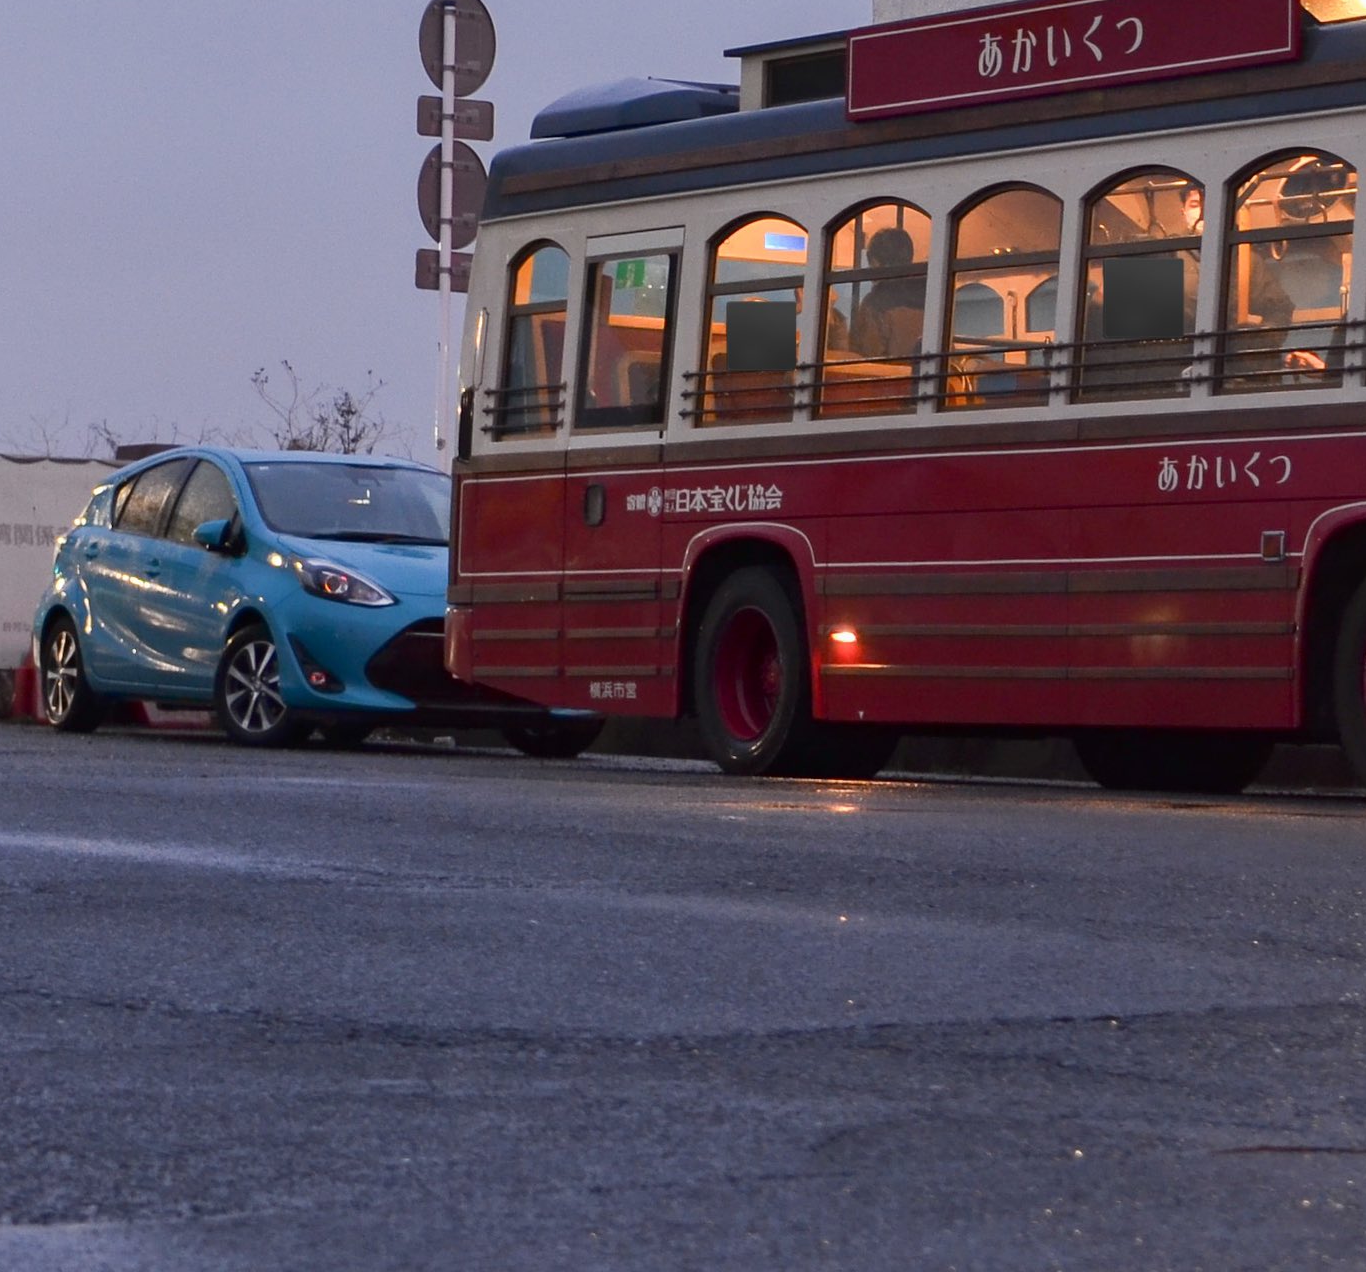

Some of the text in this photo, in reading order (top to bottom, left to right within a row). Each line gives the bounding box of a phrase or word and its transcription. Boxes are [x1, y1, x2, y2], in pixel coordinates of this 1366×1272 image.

[977, 14, 1144, 78] あかいくつ
[1157, 451, 1292, 492] あかいくつ
[675, 483, 783, 513] 日本宝くじ協会
